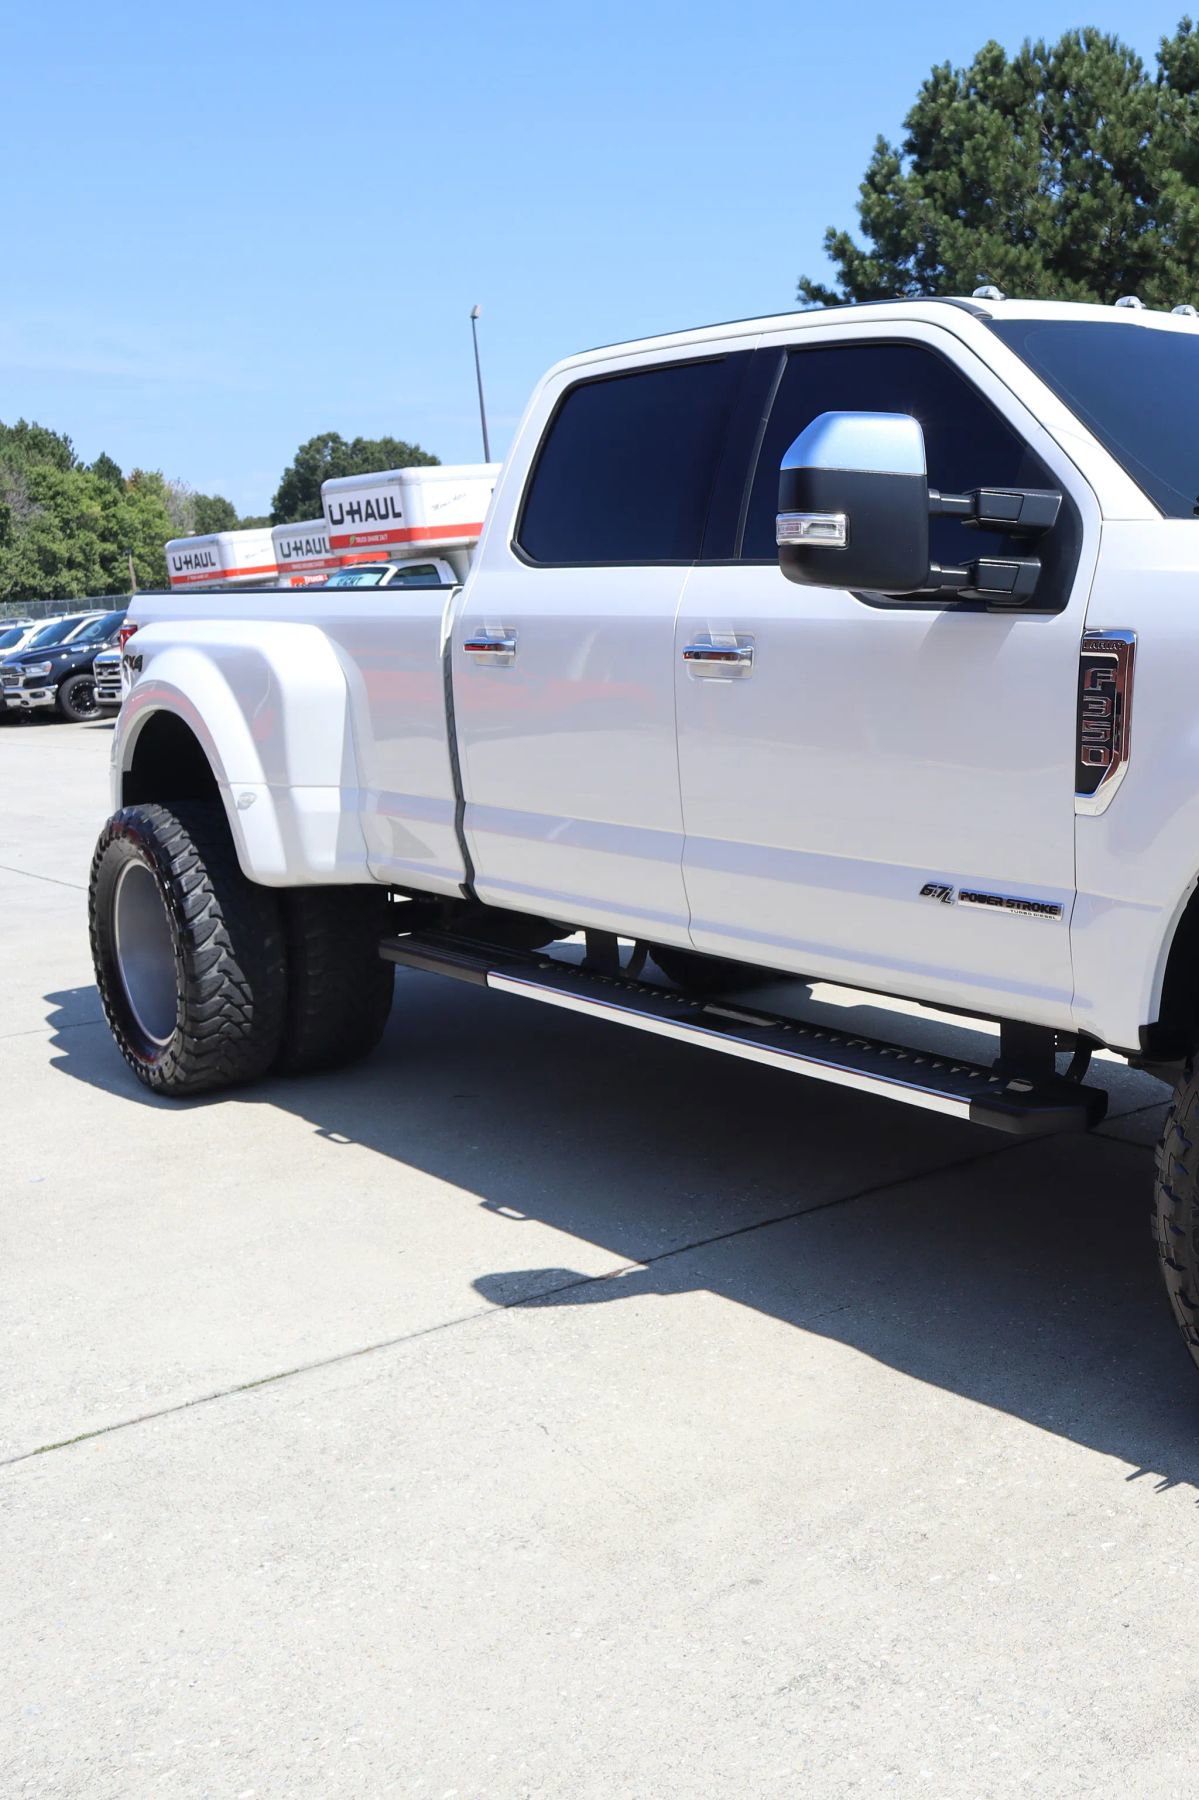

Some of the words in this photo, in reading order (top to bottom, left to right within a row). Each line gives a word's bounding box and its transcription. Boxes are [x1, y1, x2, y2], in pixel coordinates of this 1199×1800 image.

[328, 496, 402, 526] U-HAUL
[280, 537, 331, 559] U-HAUL
[172, 551, 217, 572] U-HAUL
[959, 891, 1004, 907] POWER
[1005, 899, 1060, 916] STROKE
